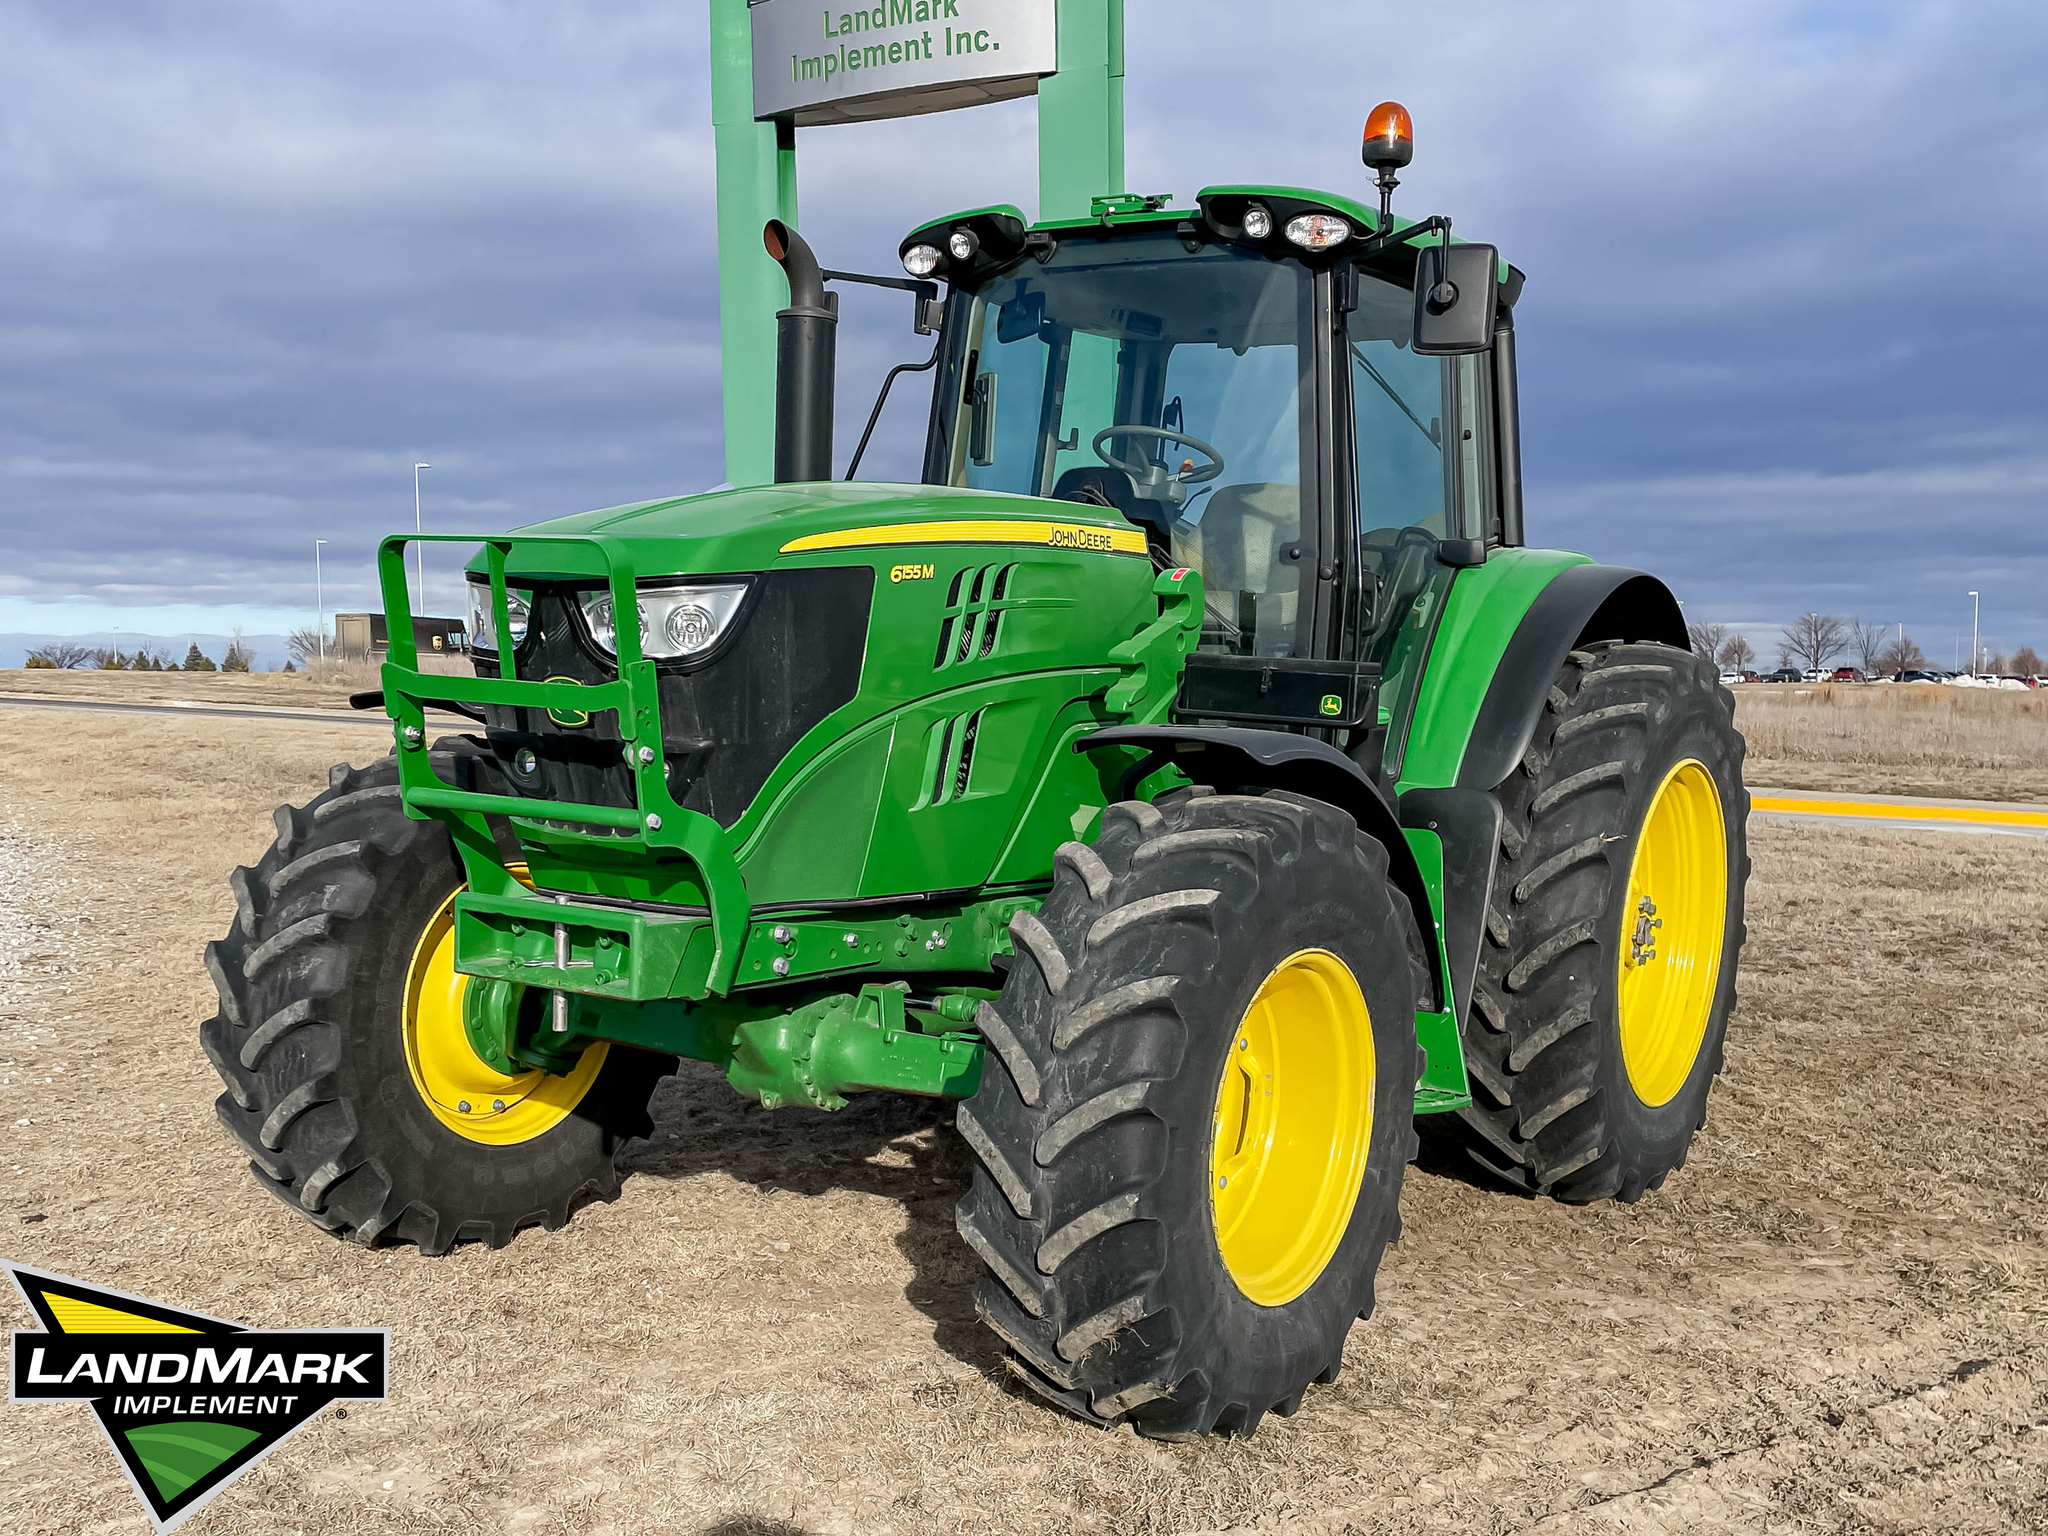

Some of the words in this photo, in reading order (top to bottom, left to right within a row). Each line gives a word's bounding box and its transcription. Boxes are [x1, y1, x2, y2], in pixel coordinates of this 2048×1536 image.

[823, 0, 959, 39] LandMark
[791, 31, 932, 82] Implement
[945, 27, 1000, 56] Inc.
[890, 564, 935, 583] 6155M
